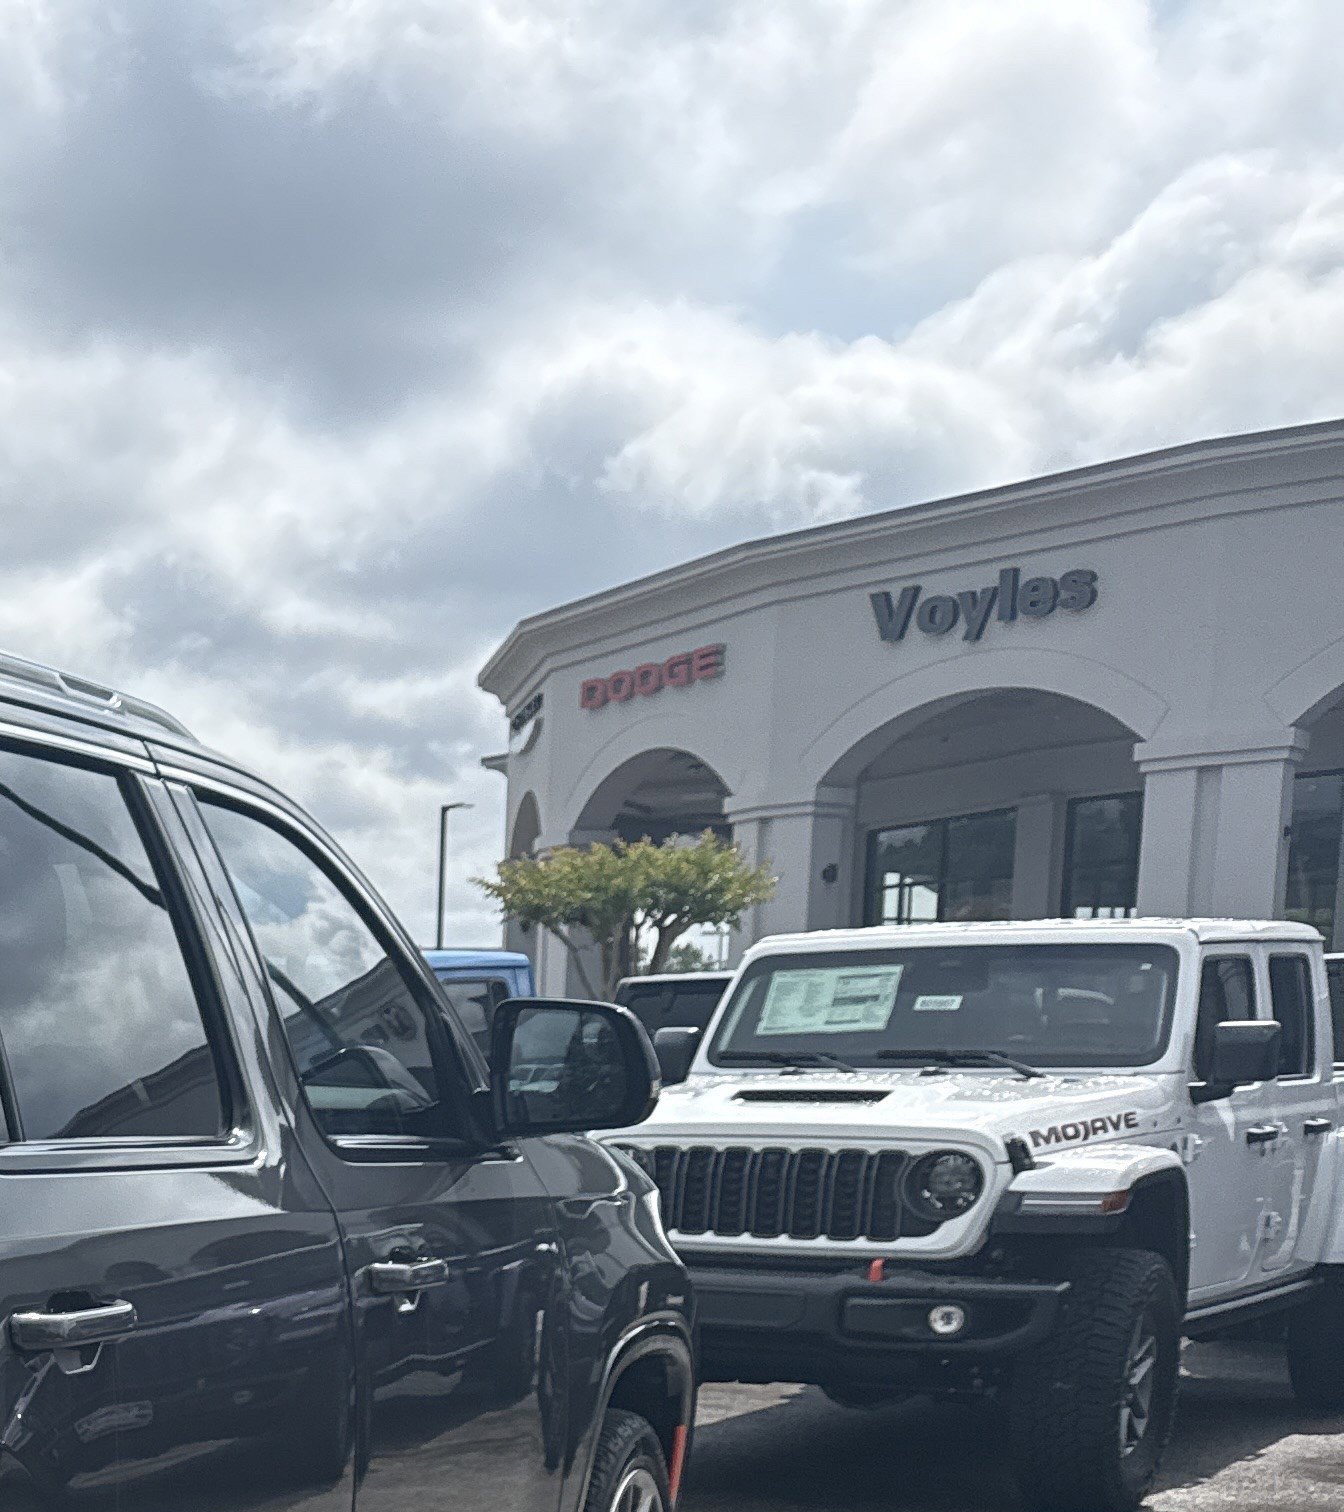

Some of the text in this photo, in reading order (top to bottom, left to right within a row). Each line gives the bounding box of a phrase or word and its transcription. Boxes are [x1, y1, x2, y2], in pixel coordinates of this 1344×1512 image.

[870, 567, 1099, 642] Voyles
[580, 643, 727, 711] DODGE
[1029, 1111, 1140, 1147] MOJAVE
